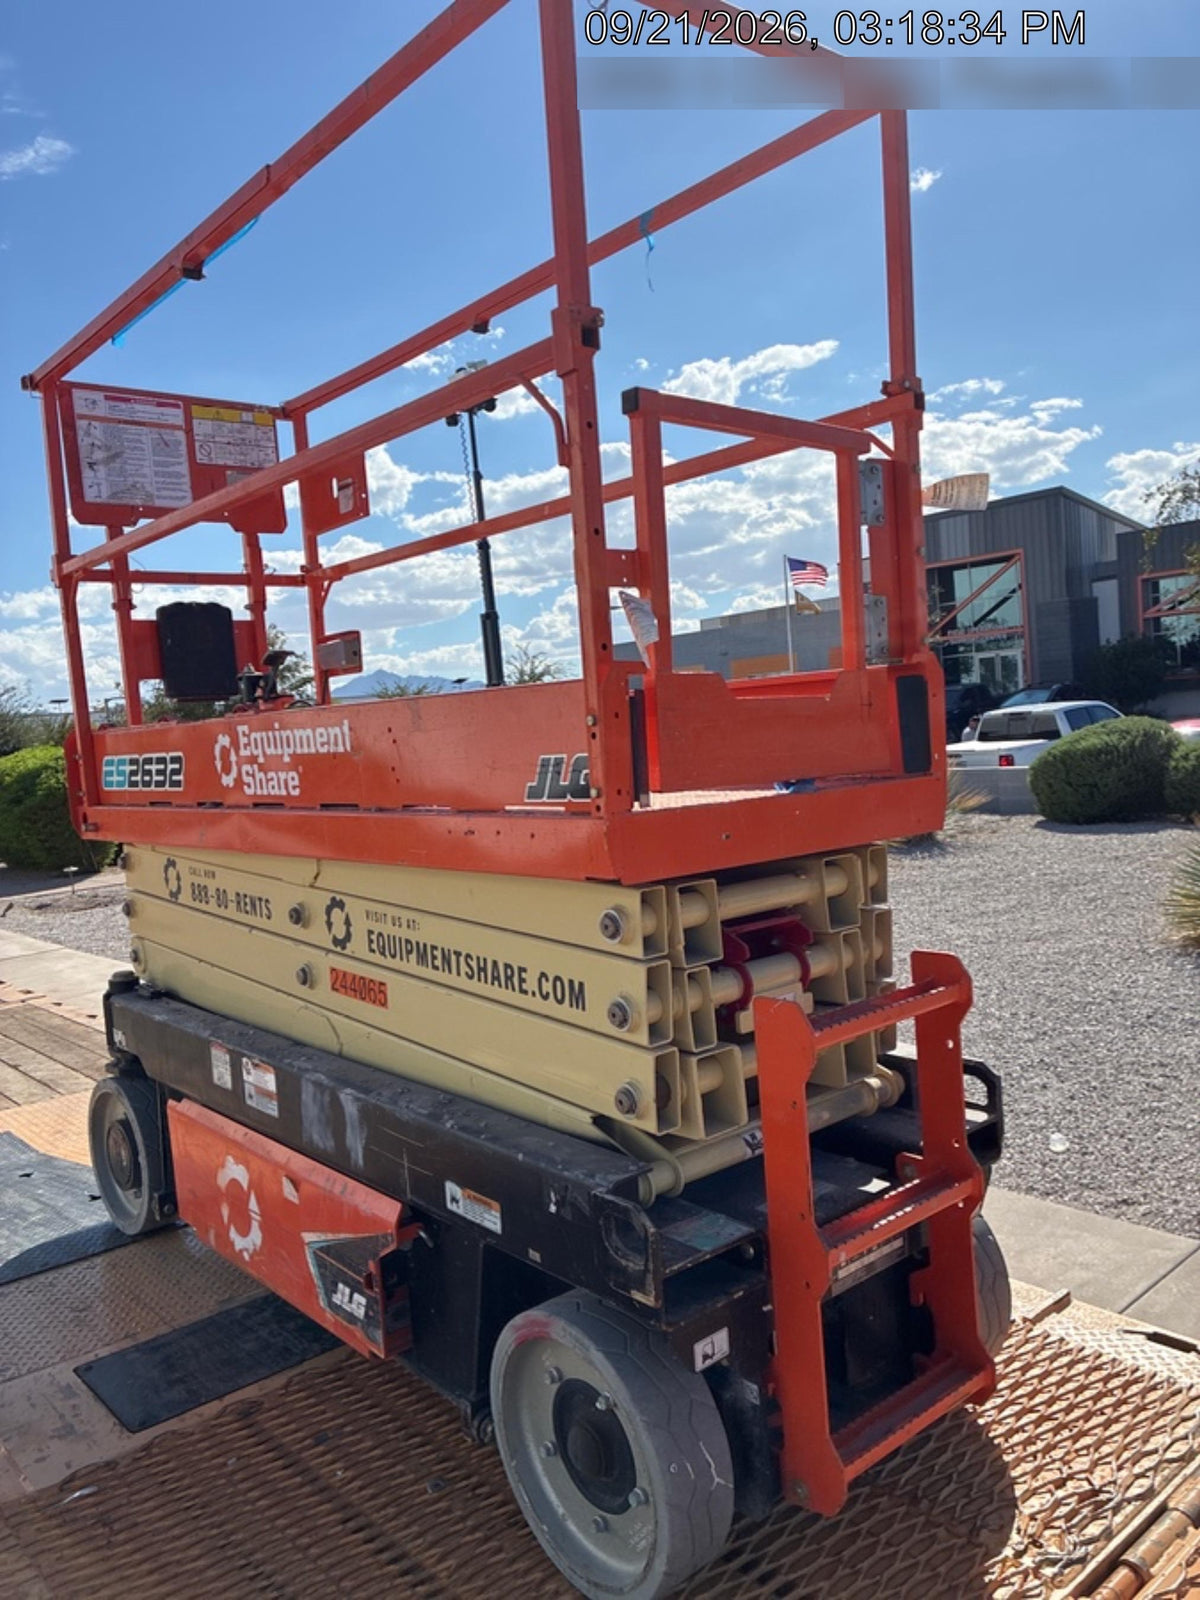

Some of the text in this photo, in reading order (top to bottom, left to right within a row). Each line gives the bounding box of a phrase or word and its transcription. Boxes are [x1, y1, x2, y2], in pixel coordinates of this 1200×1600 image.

[236, 719, 352, 764] Equipment
[103, 752, 184, 791] ES2632
[241, 764, 301, 797] Share
[188, 865, 203, 877] CALL
[190, 881, 273, 920] 888-80-RENTS
[364, 908, 420, 931] VISIT US AT:
[330, 968, 388, 1008] 244065
[366, 928, 588, 1012] EQUIPMENTSHARE.COM
[332, 1282, 367, 1320] JLG
